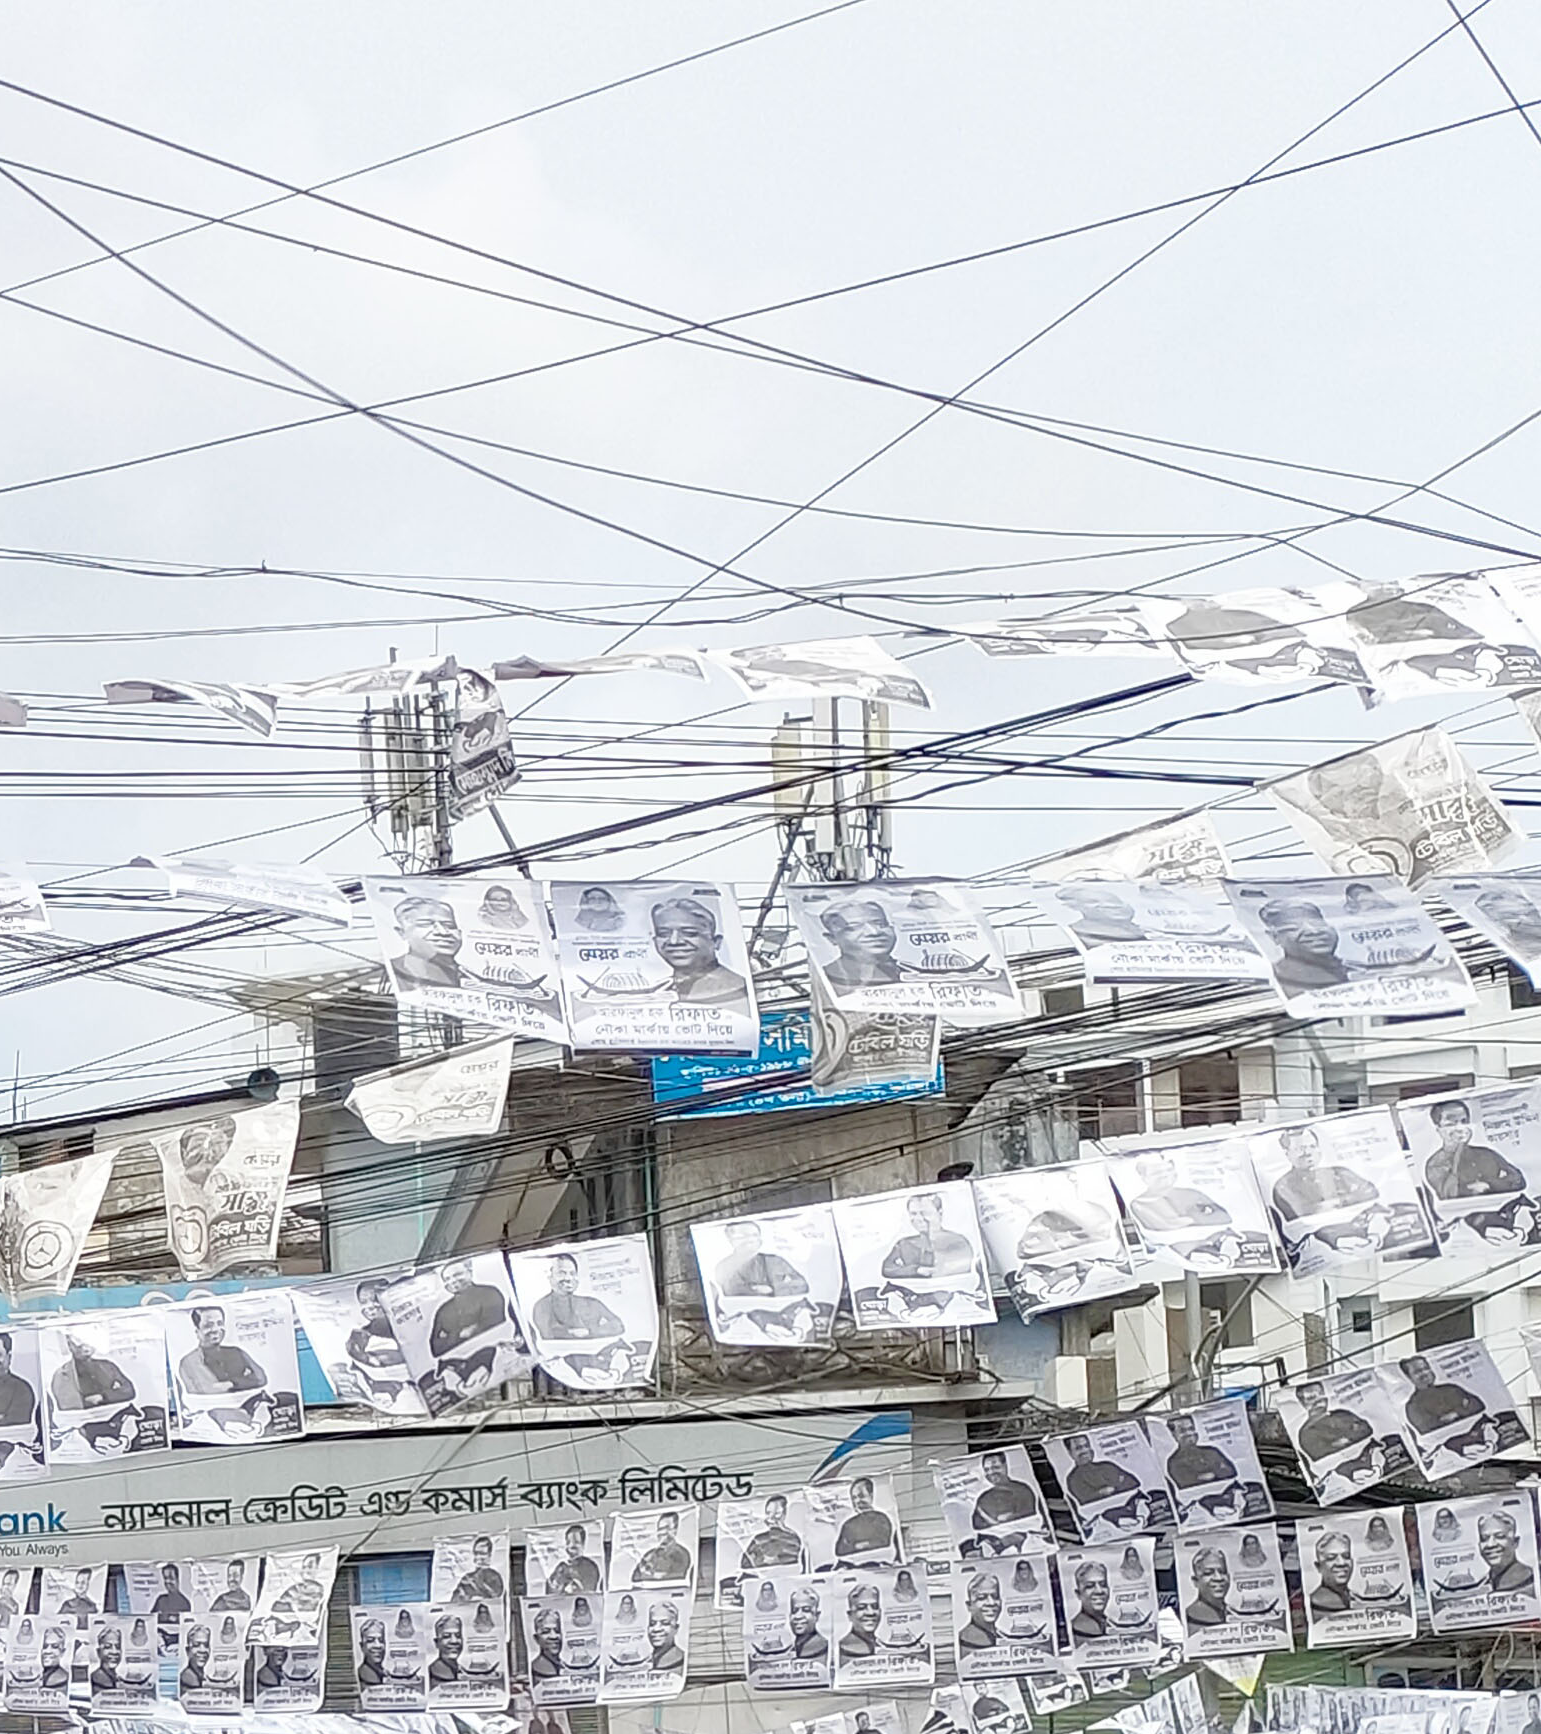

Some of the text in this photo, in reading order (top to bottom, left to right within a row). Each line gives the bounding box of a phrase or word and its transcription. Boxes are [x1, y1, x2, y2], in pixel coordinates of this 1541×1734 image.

[101, 1499, 233, 1532] ন্যাশনাল
[243, 1484, 348, 1523] ক্রেডিট
[421, 1478, 509, 1514] কমার্স
[519, 1478, 609, 1511] ব্যাংক
[619, 1465, 755, 1505] লিমিটেড
[25, 1541, 69, 1558] Always
